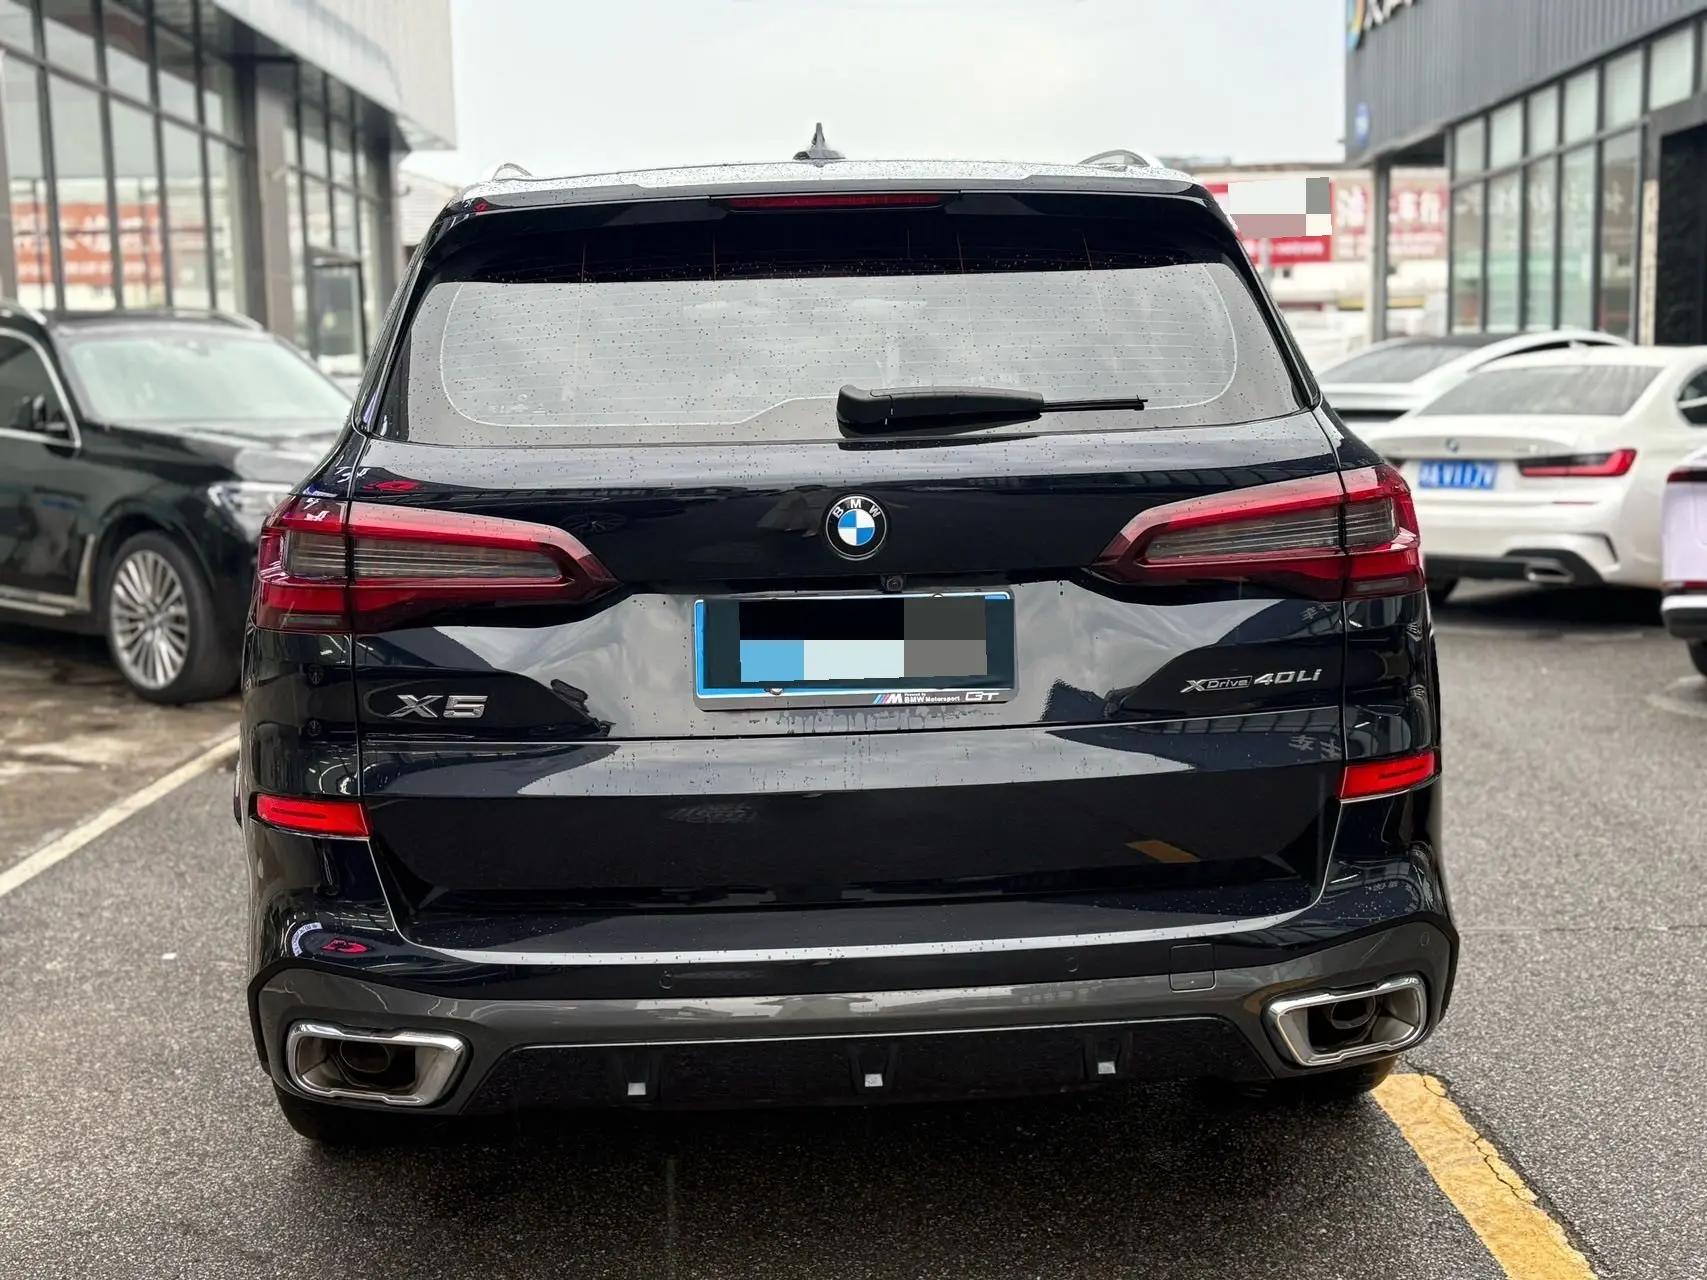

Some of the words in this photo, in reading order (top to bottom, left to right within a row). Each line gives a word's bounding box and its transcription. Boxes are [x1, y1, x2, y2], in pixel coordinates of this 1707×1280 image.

[832, 498, 881, 519] BMW
[1253, 668, 1322, 686] 40Li
[386, 694, 488, 718] X5
[904, 696, 925, 704] BMW
[925, 695, 960, 703] Motorsport
[965, 691, 1000, 701] GT
